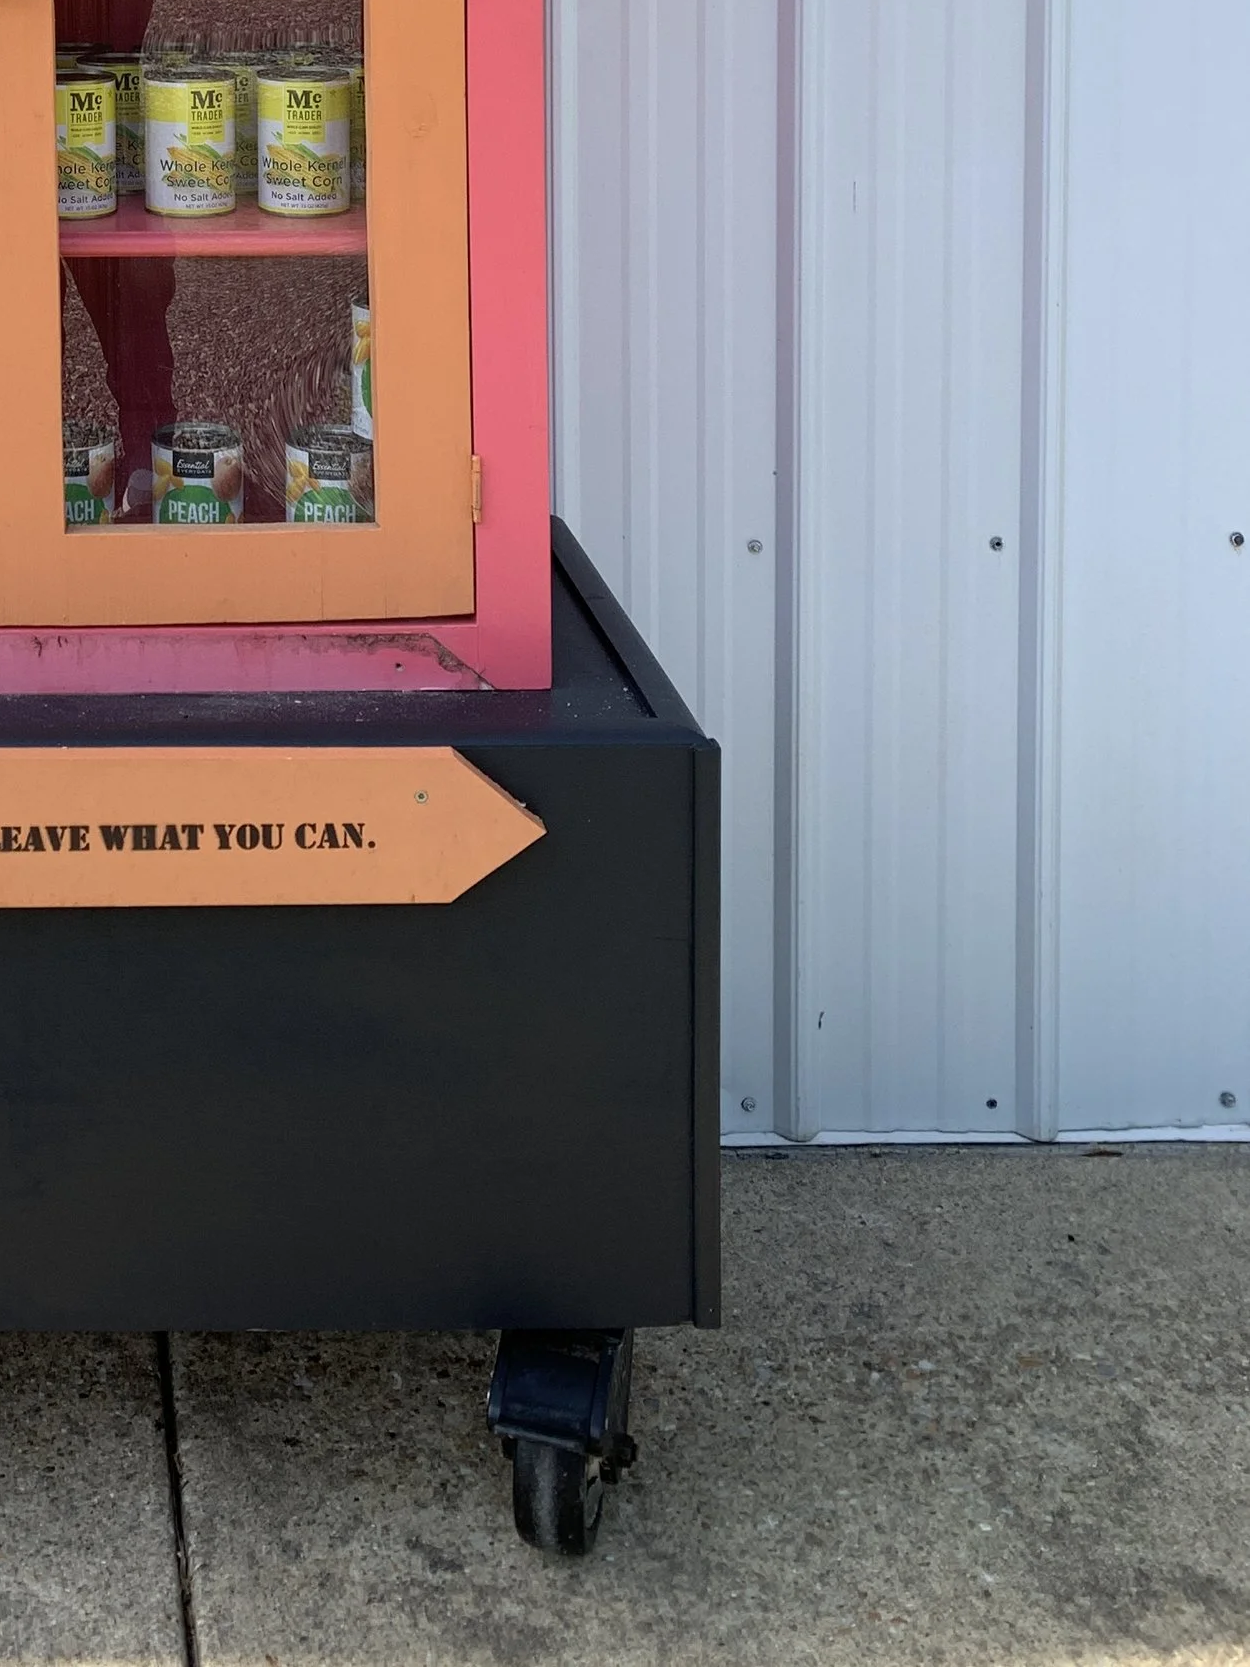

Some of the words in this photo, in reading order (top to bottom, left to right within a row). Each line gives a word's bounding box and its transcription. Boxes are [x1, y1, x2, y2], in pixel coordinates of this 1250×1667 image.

[71, 112, 102, 124] TRADER
[192, 110, 223, 121] TRADER
[287, 110, 322, 121] TRADER
[160, 159, 206, 173] Whole
[262, 156, 302, 171] Whole
[308, 157, 347, 172] Kernel
[166, 175, 210, 188] Sweet
[266, 173, 306, 187] Sweet
[312, 175, 342, 192] Corn
[71, 195, 88, 204] Salt
[174, 194, 188, 202] No
[191, 194, 208, 202] Salt
[271, 191, 283, 199] No
[286, 192, 303, 201] Salt
[308, 193, 337, 201] Added
[177, 459, 210, 470] Essential
[66, 499, 95, 522] ACH
[169, 501, 219, 523] PEACH
[304, 502, 356, 522] PEACH
[98, 824, 205, 851] WHAT
[213, 823, 285, 850] YOU
[294, 822, 376, 850] CAN.
